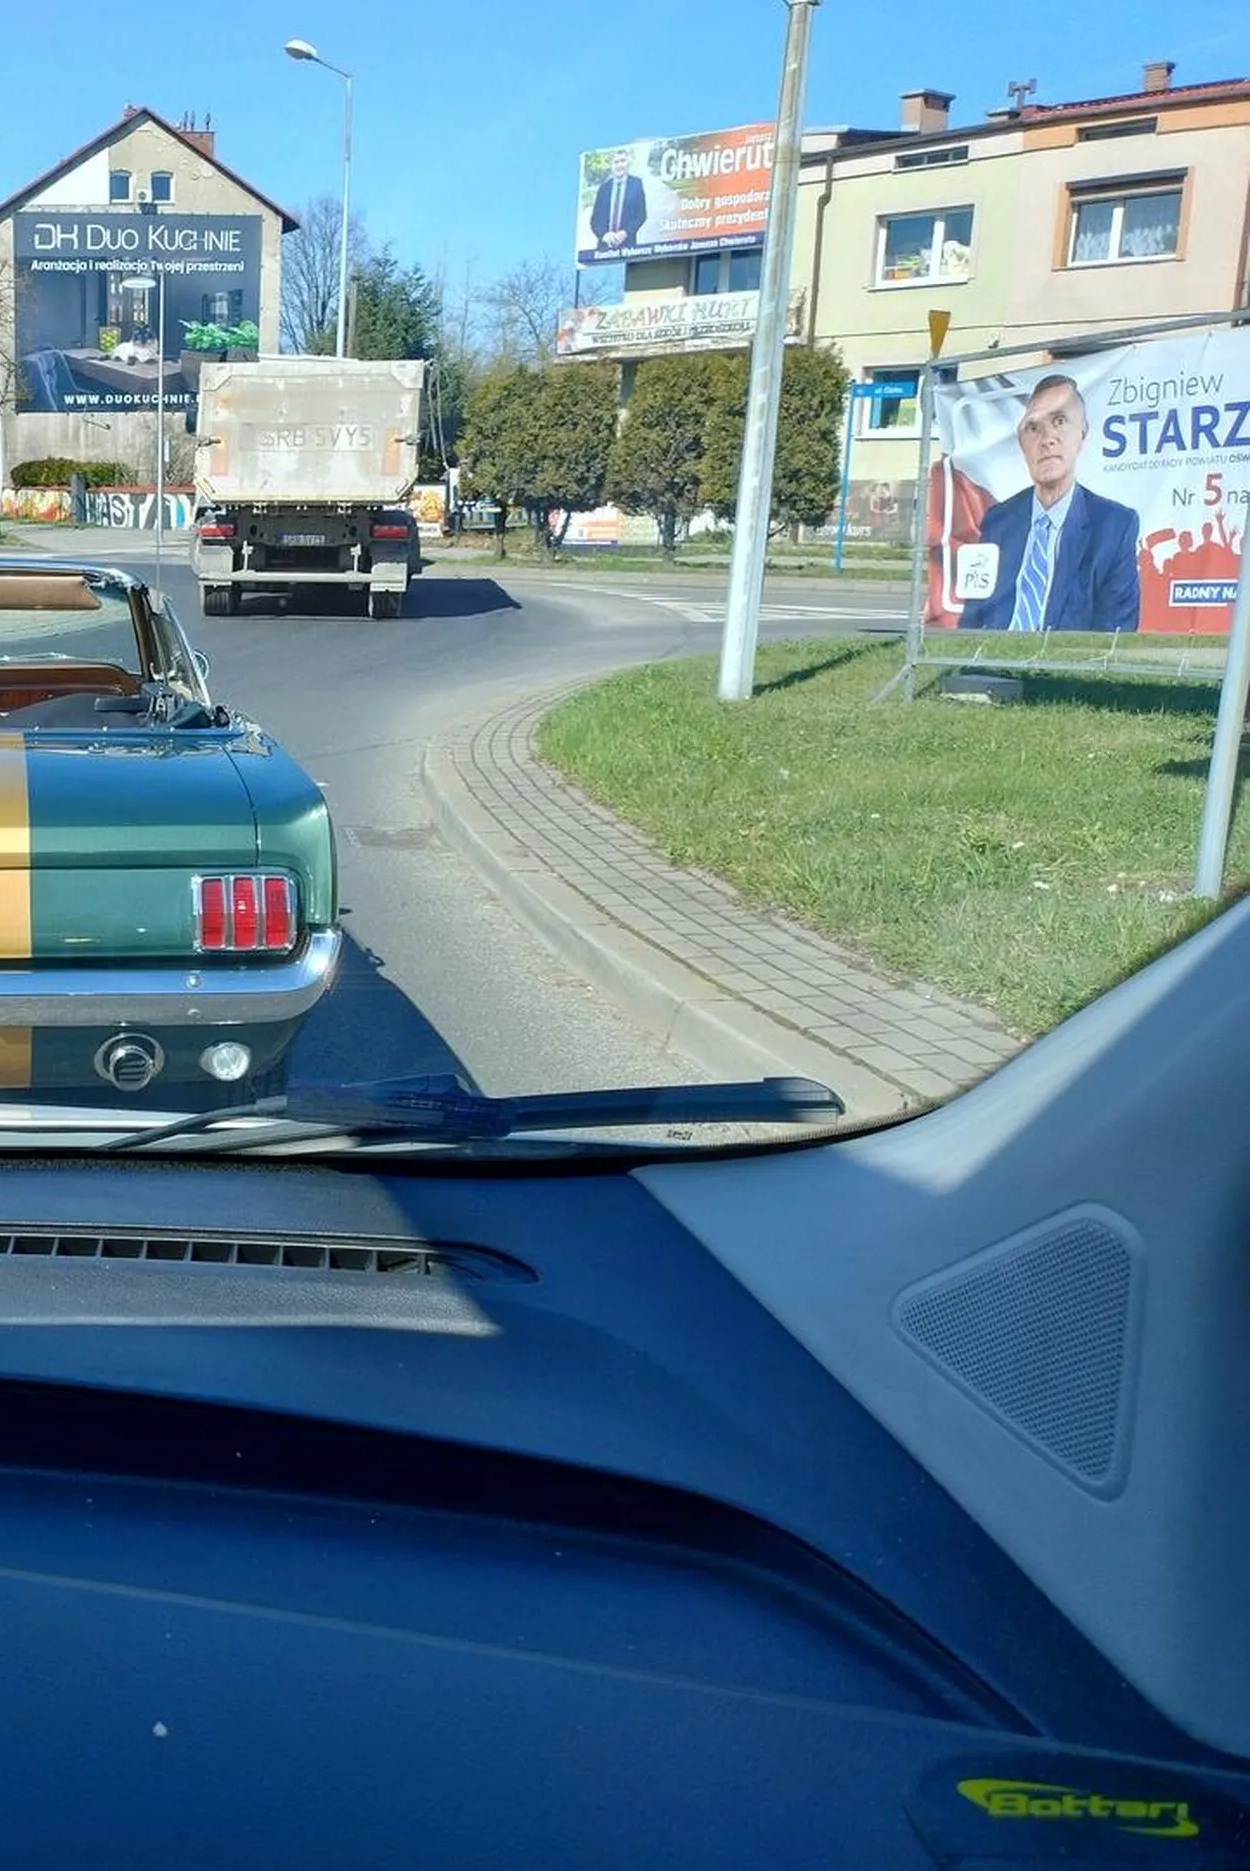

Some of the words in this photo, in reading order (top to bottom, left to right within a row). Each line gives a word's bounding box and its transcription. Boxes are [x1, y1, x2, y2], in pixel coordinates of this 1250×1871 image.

[660, 141, 774, 180] Chwierut
[31, 260, 88, 274] Aranżacja
[95, 260, 148, 274] realizacja
[186, 260, 244, 274] przestrzeni
[1107, 371, 1225, 409] Zbigniew
[1102, 400, 1250, 459] STARZ
[1172, 488, 1196, 506] Nr
[1204, 472, 1223, 507] 5
[1227, 489, 1250, 504] na
[1174, 586, 1221, 600] RADNY
